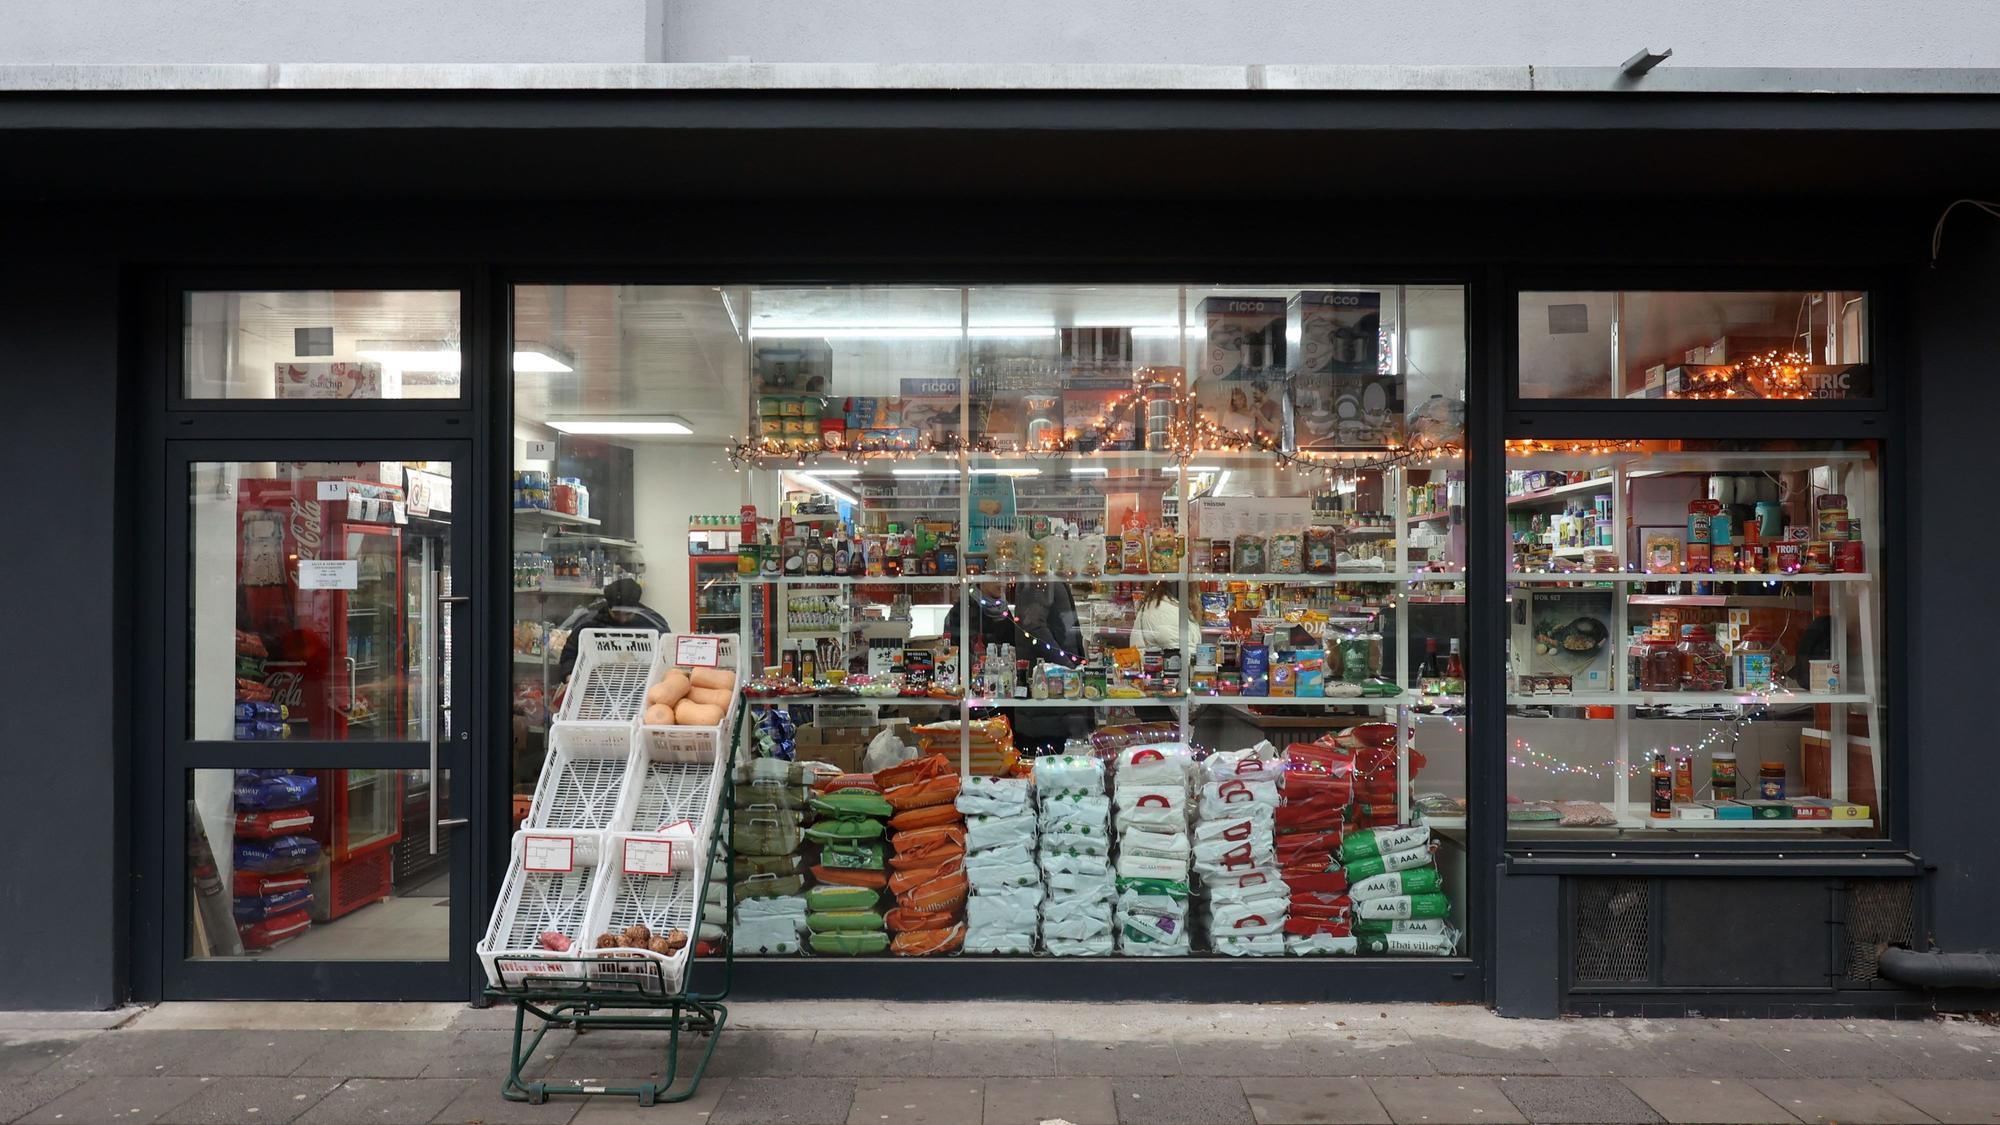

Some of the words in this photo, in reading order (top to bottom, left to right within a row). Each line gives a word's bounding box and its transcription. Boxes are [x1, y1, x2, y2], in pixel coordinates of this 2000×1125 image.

[1323, 294, 1359, 306] ricco
[1229, 301, 1264, 312] ricco
[922, 381, 956, 393] ricco
[535, 444, 544, 452] 13
[1394, 834, 1412, 845] AAA
[1400, 853, 1418, 864] AAA
[1367, 883, 1385, 891] AAA
[1376, 903, 1395, 911] AAA
[1390, 940, 1411, 950] Thai
[1413, 941, 1442, 953] villag
